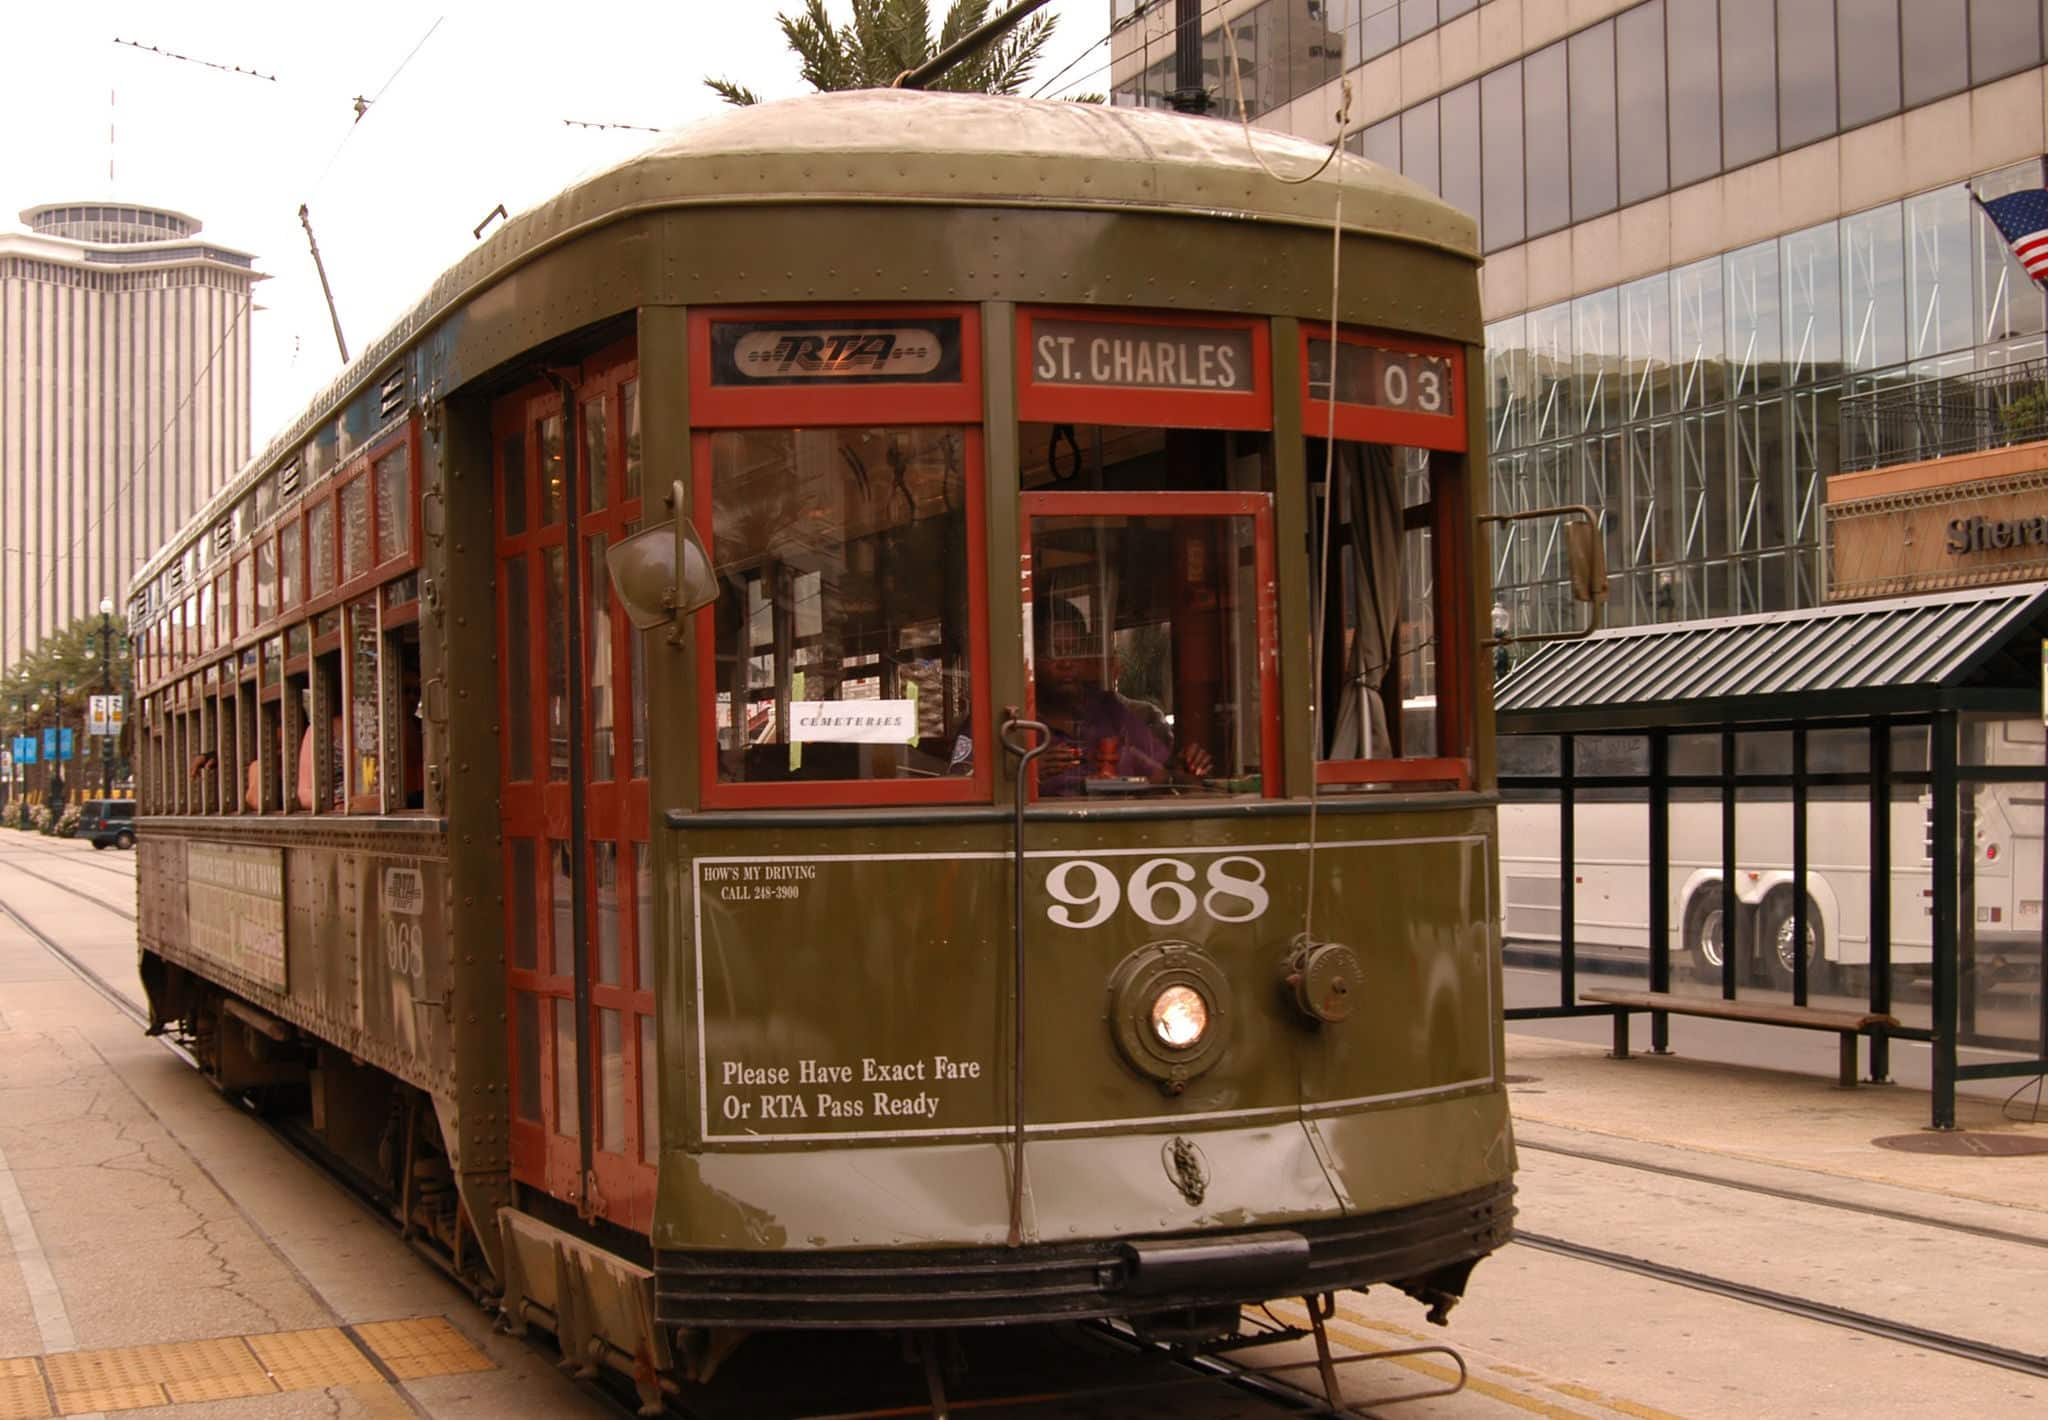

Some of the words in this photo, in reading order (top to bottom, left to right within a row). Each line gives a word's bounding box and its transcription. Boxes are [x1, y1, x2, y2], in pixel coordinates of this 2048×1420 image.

[778, 333, 897, 367] RTA
[1037, 335, 1082, 380] ST.
[1090, 338, 1237, 388] CHARLES
[1384, 364, 1442, 411] 03
[799, 716, 903, 727] CEMETERIES
[704, 867, 740, 881] HOW'S
[743, 867, 761, 881] MY
[765, 865, 816, 880] DRIVING
[721, 886, 751, 900] CALL
[753, 886, 799, 899] 248-3900
[1045, 855, 1270, 929] 968
[722, 1061, 790, 1085] Please
[799, 1060, 852, 1083] Have
[862, 1058, 926, 1082] Exact
[934, 1056, 981, 1080] Fare
[723, 1095, 751, 1119] Or
[760, 1094, 808, 1118] RTA
[817, 1094, 863, 1117] Pass
[873, 1092, 940, 1118] Ready
